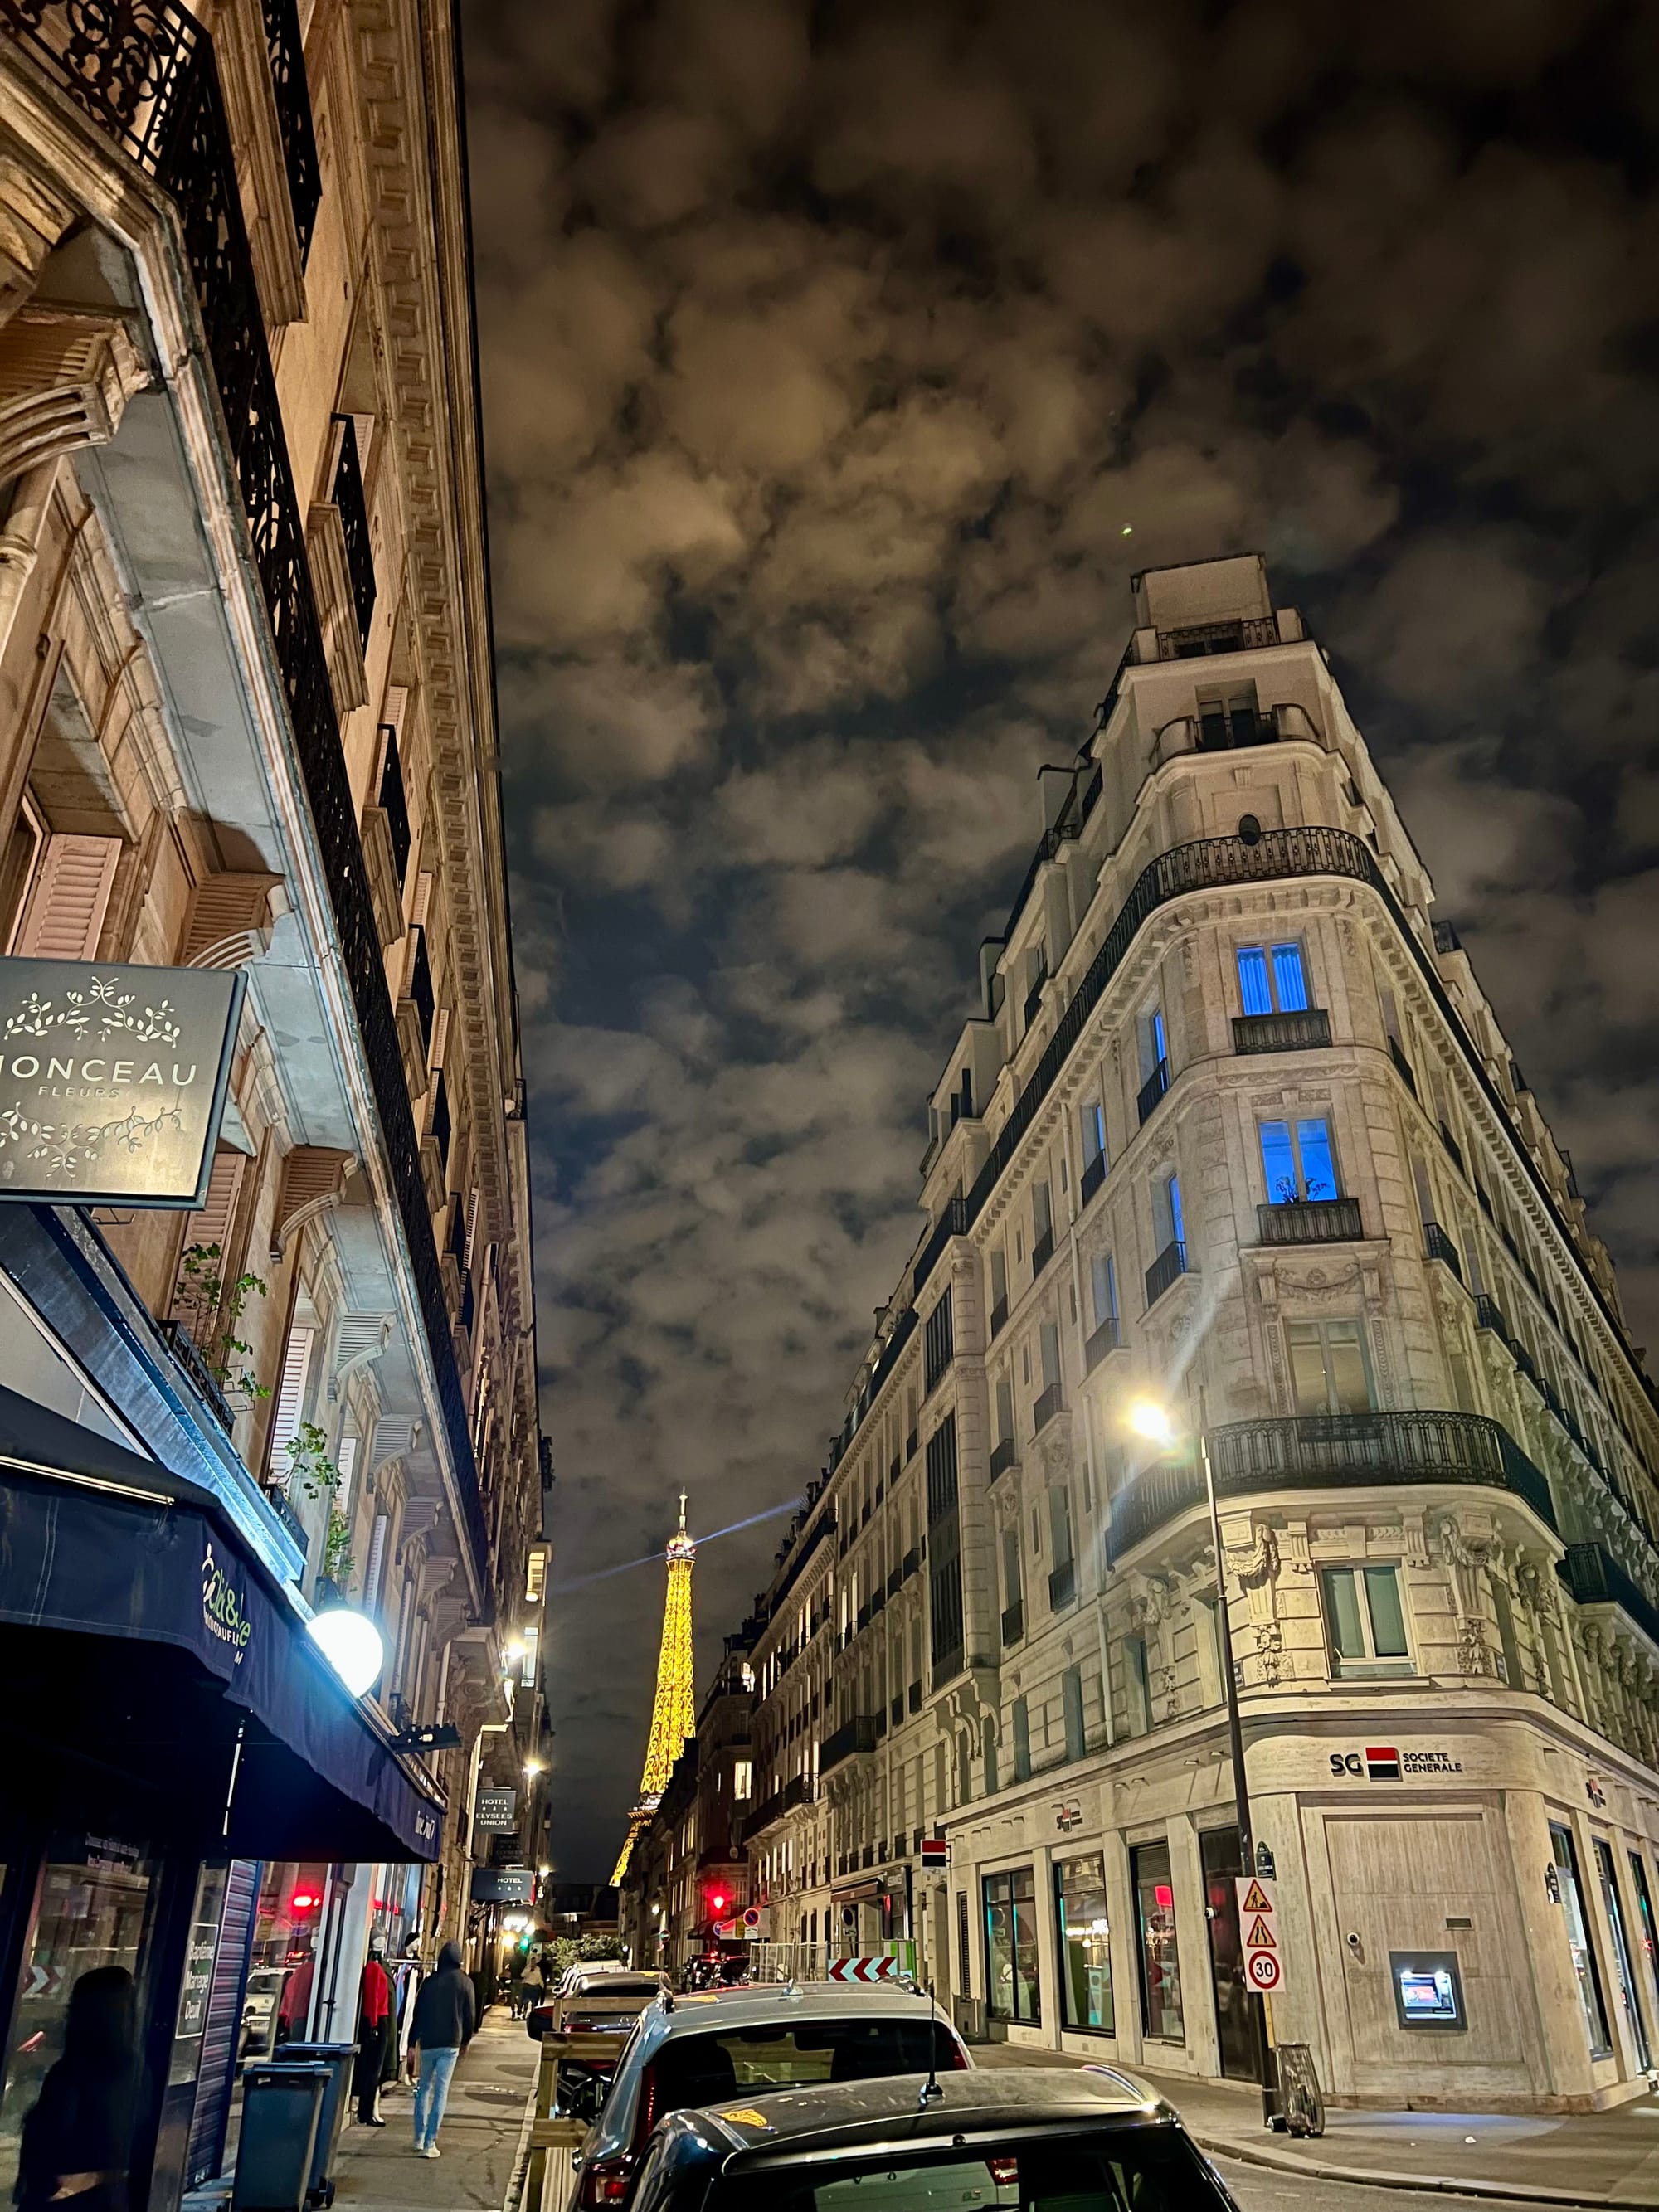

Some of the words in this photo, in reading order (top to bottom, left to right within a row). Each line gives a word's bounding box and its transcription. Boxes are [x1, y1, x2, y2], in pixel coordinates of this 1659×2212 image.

[0, 1054, 197, 1087] ONCEAU
[38, 1085, 120, 1098] FLEURS
[1330, 1753, 1363, 1776] SG
[1403, 1752, 1450, 1763] SOCIETE
[1404, 1762, 1463, 1774] GENERALE
[1256, 1962, 1273, 1977] 30
